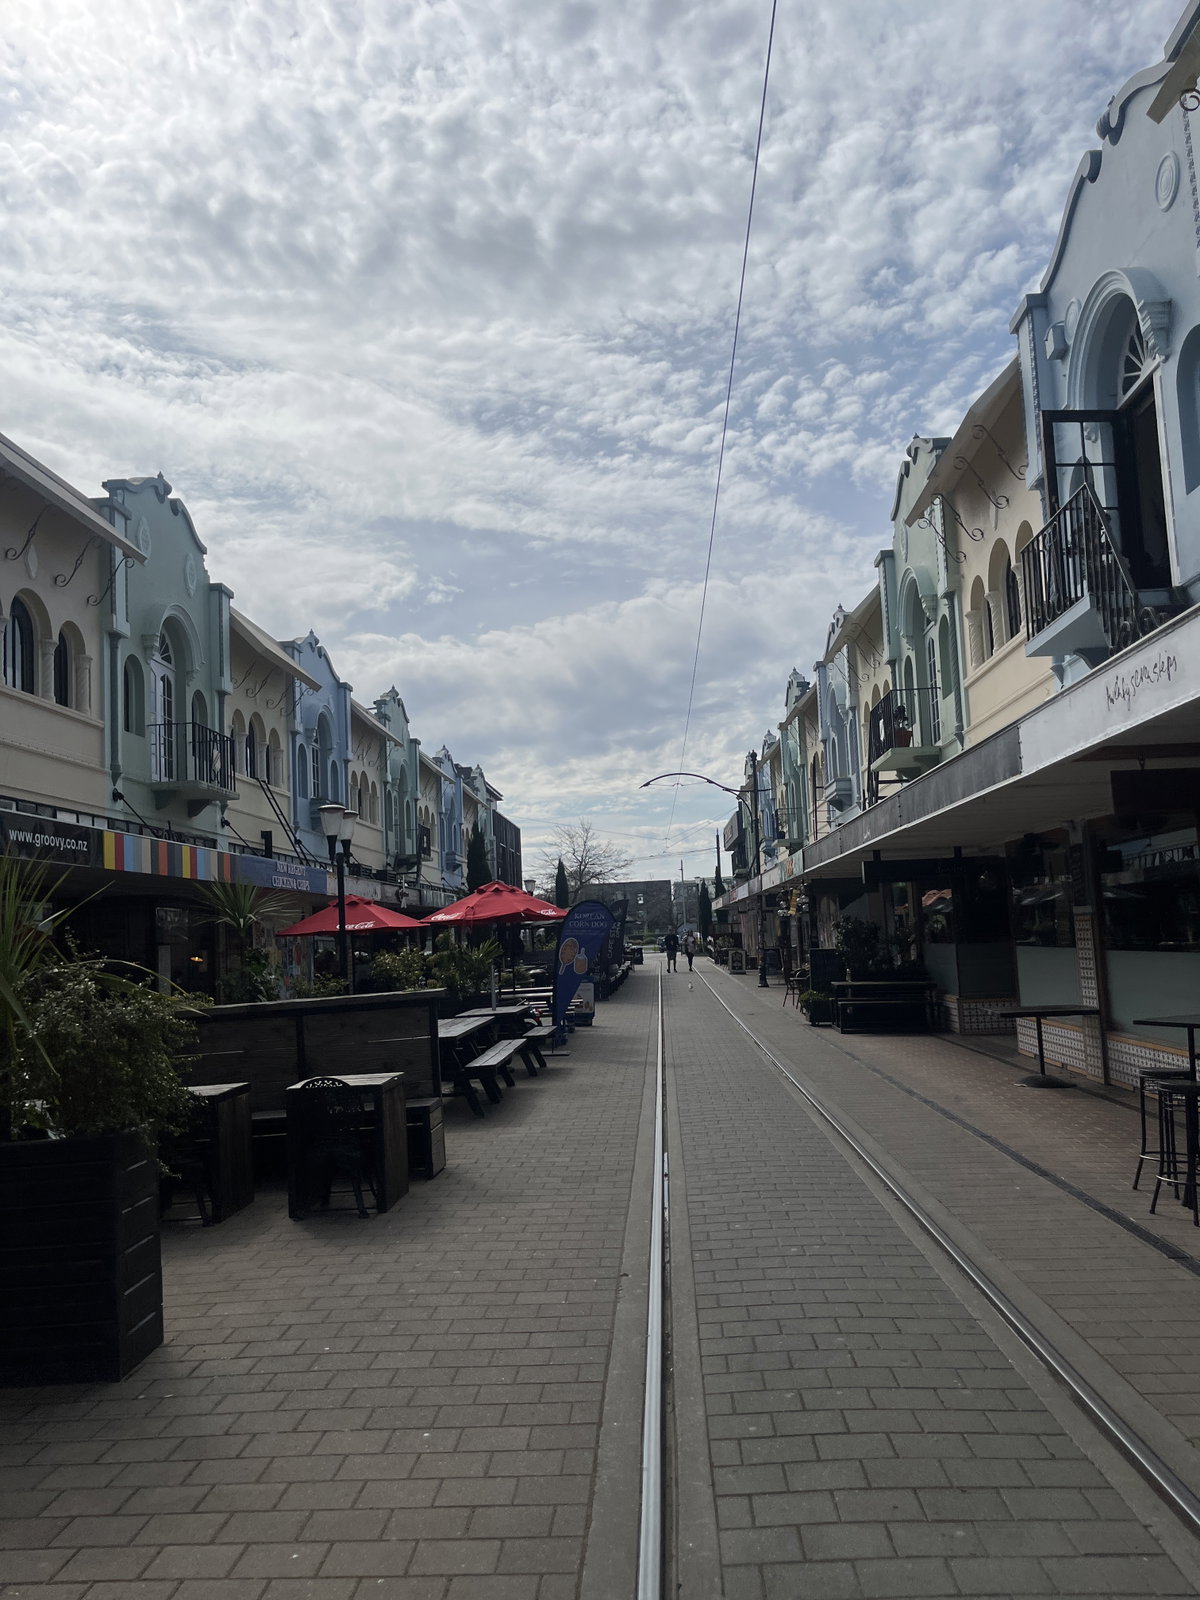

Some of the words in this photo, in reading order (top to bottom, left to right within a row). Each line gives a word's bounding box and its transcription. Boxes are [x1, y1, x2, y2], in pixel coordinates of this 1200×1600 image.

[8, 829, 88, 851] www.groovy.co.nz
[574, 912, 605, 920] KOREAN
[569, 920, 590, 928] CORN
[591, 920, 608, 928] DOG
